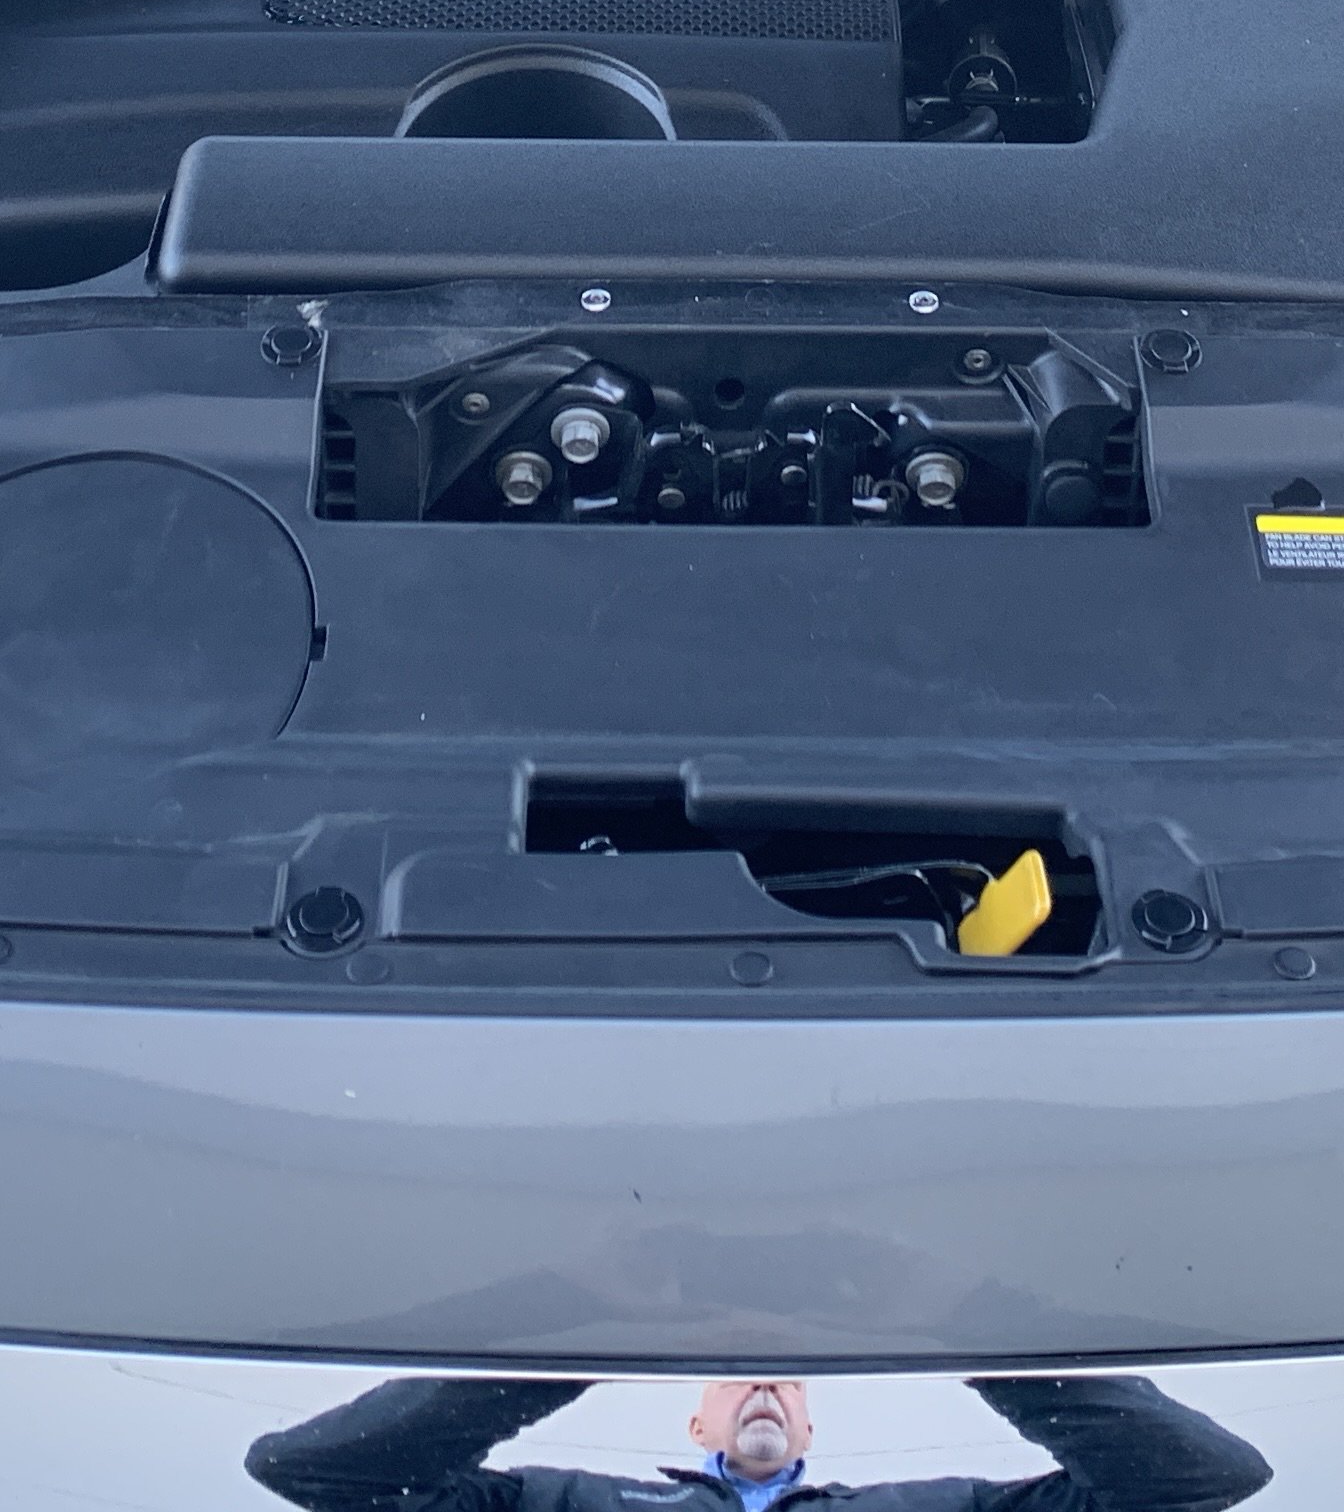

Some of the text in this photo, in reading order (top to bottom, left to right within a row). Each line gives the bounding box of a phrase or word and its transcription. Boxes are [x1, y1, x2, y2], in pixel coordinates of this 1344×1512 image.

[1312, 534, 1332, 542] CAN
[1267, 541, 1280, 549] TO
[1280, 541, 1303, 549] HELP
[1304, 542, 1331, 550] AVOID
[1267, 549, 1280, 557] LE
[1280, 549, 1336, 558] VENTILATEUR
[1269, 558, 1296, 566] POUR
